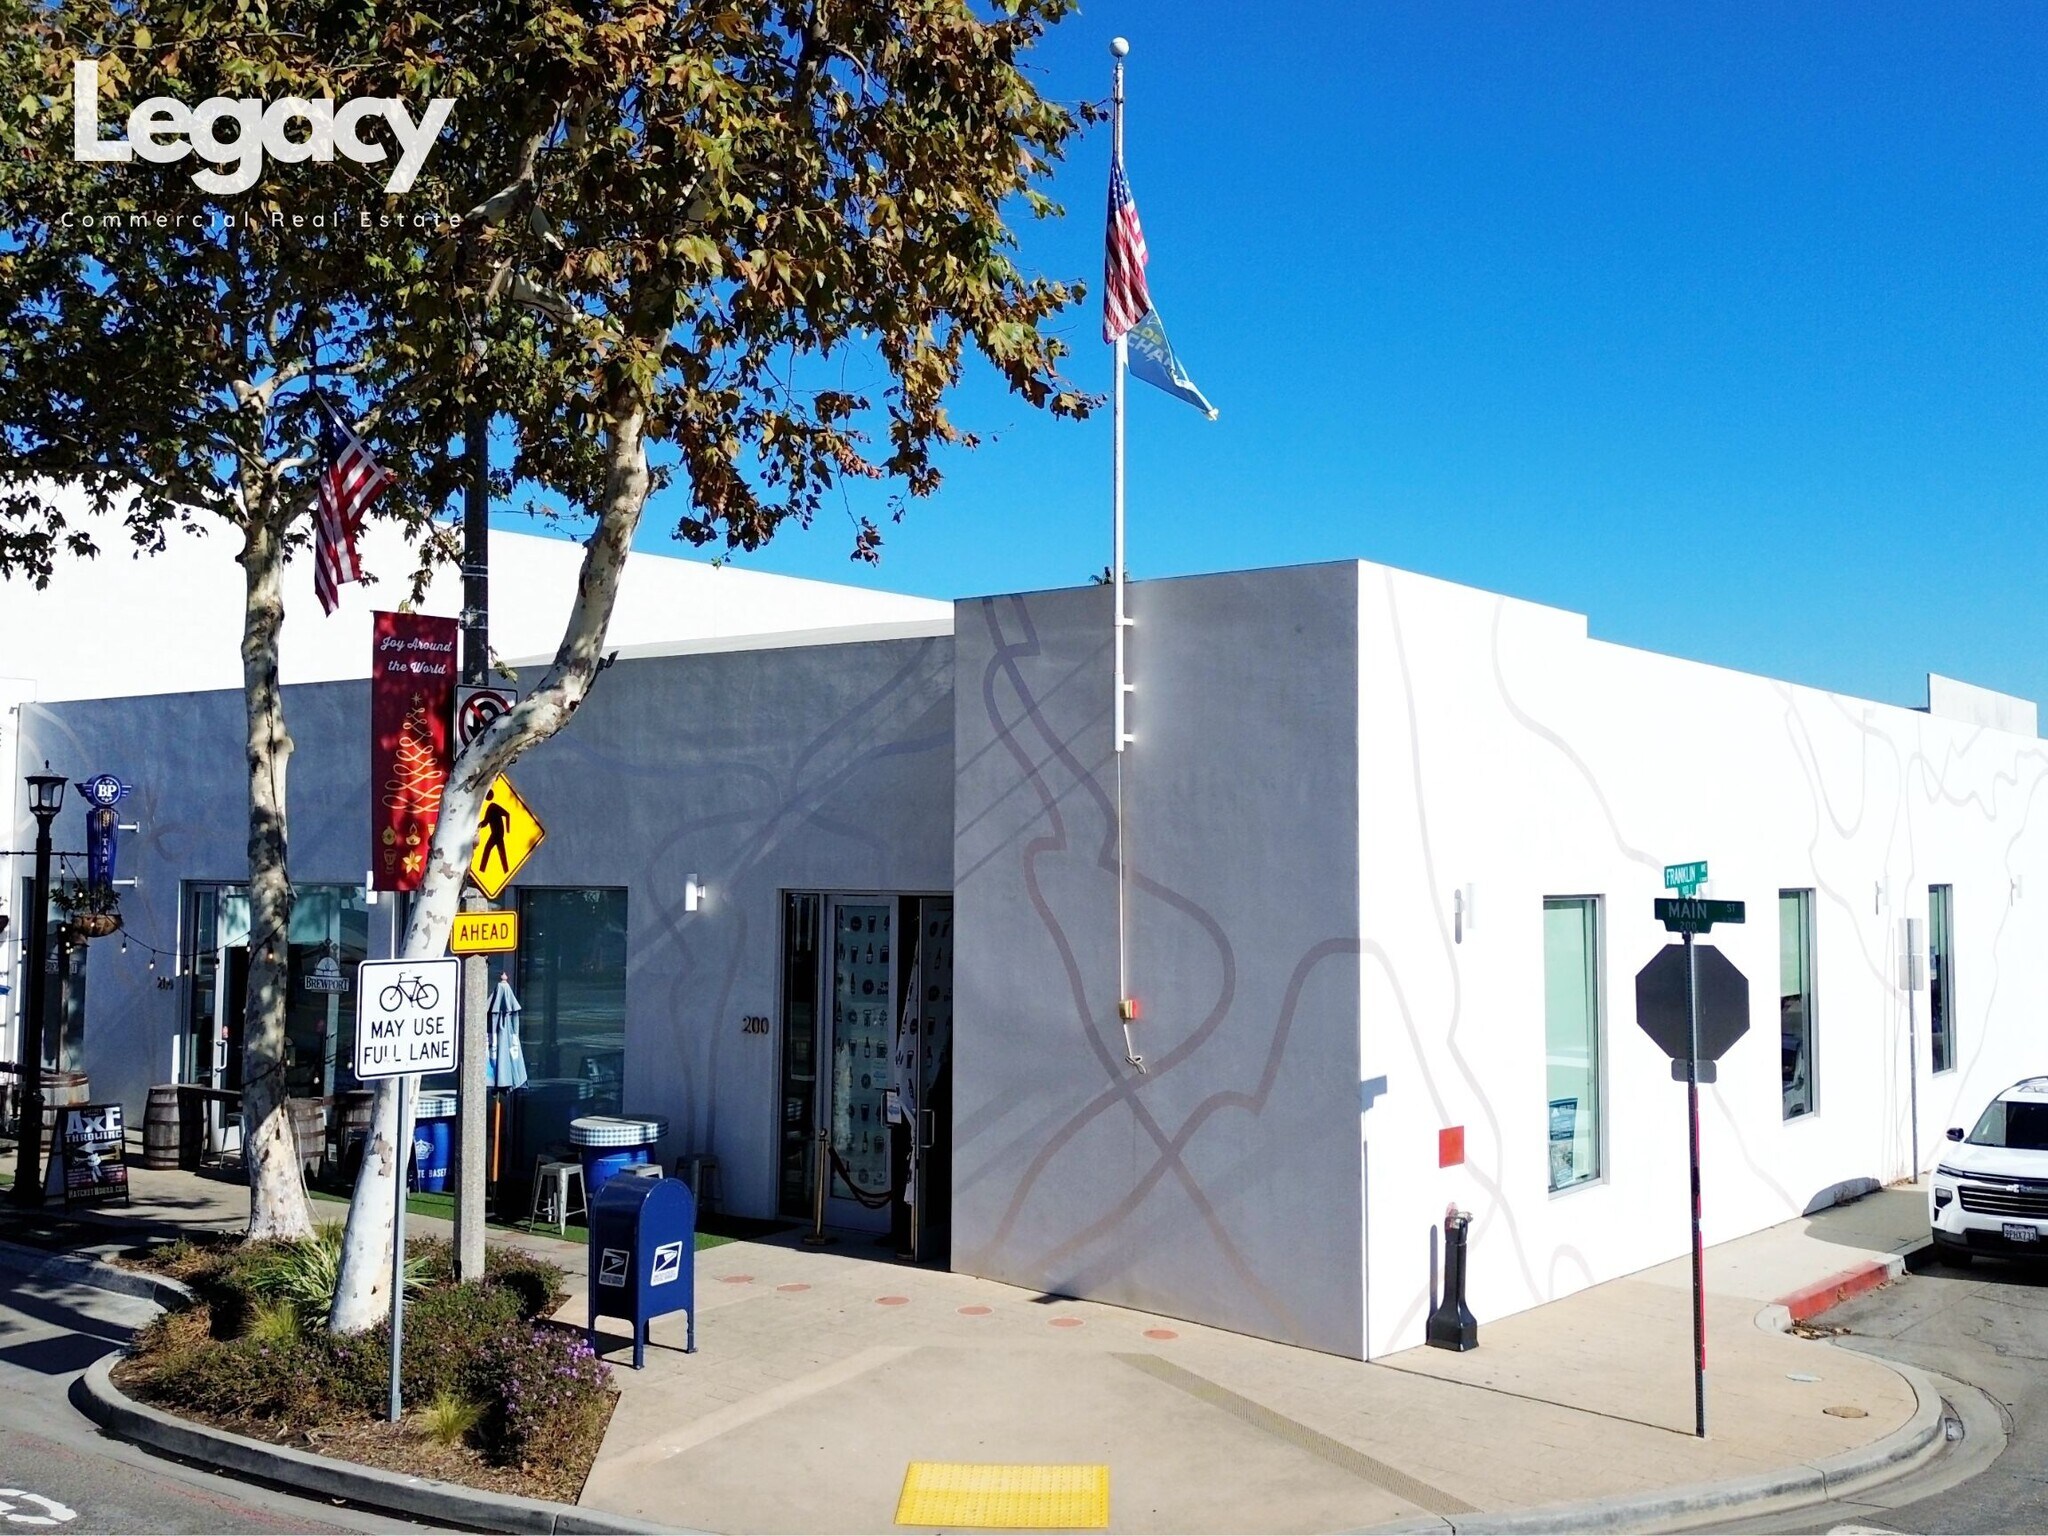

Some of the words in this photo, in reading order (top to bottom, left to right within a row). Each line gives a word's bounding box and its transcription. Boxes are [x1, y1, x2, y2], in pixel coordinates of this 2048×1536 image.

[380, 636, 405, 652] Joy
[407, 637, 452, 652] Around
[388, 660, 408, 671] the
[410, 661, 447, 675] World
[97, 784, 117, 798] BP
[1666, 865, 1696, 886] FRANKLIN
[1668, 902, 1707, 919] MAIN
[1726, 904, 1736, 913] ST
[460, 922, 509, 942] AHEAD
[1679, 920, 1697, 932] 200
[305, 976, 348, 991] BREWPORT
[371, 1019, 405, 1039] MAY
[414, 1016, 445, 1036] USE
[742, 1015, 769, 1035] 200
[410, 1040, 450, 1061] LANE
[65, 1129, 123, 1143] THROWING
